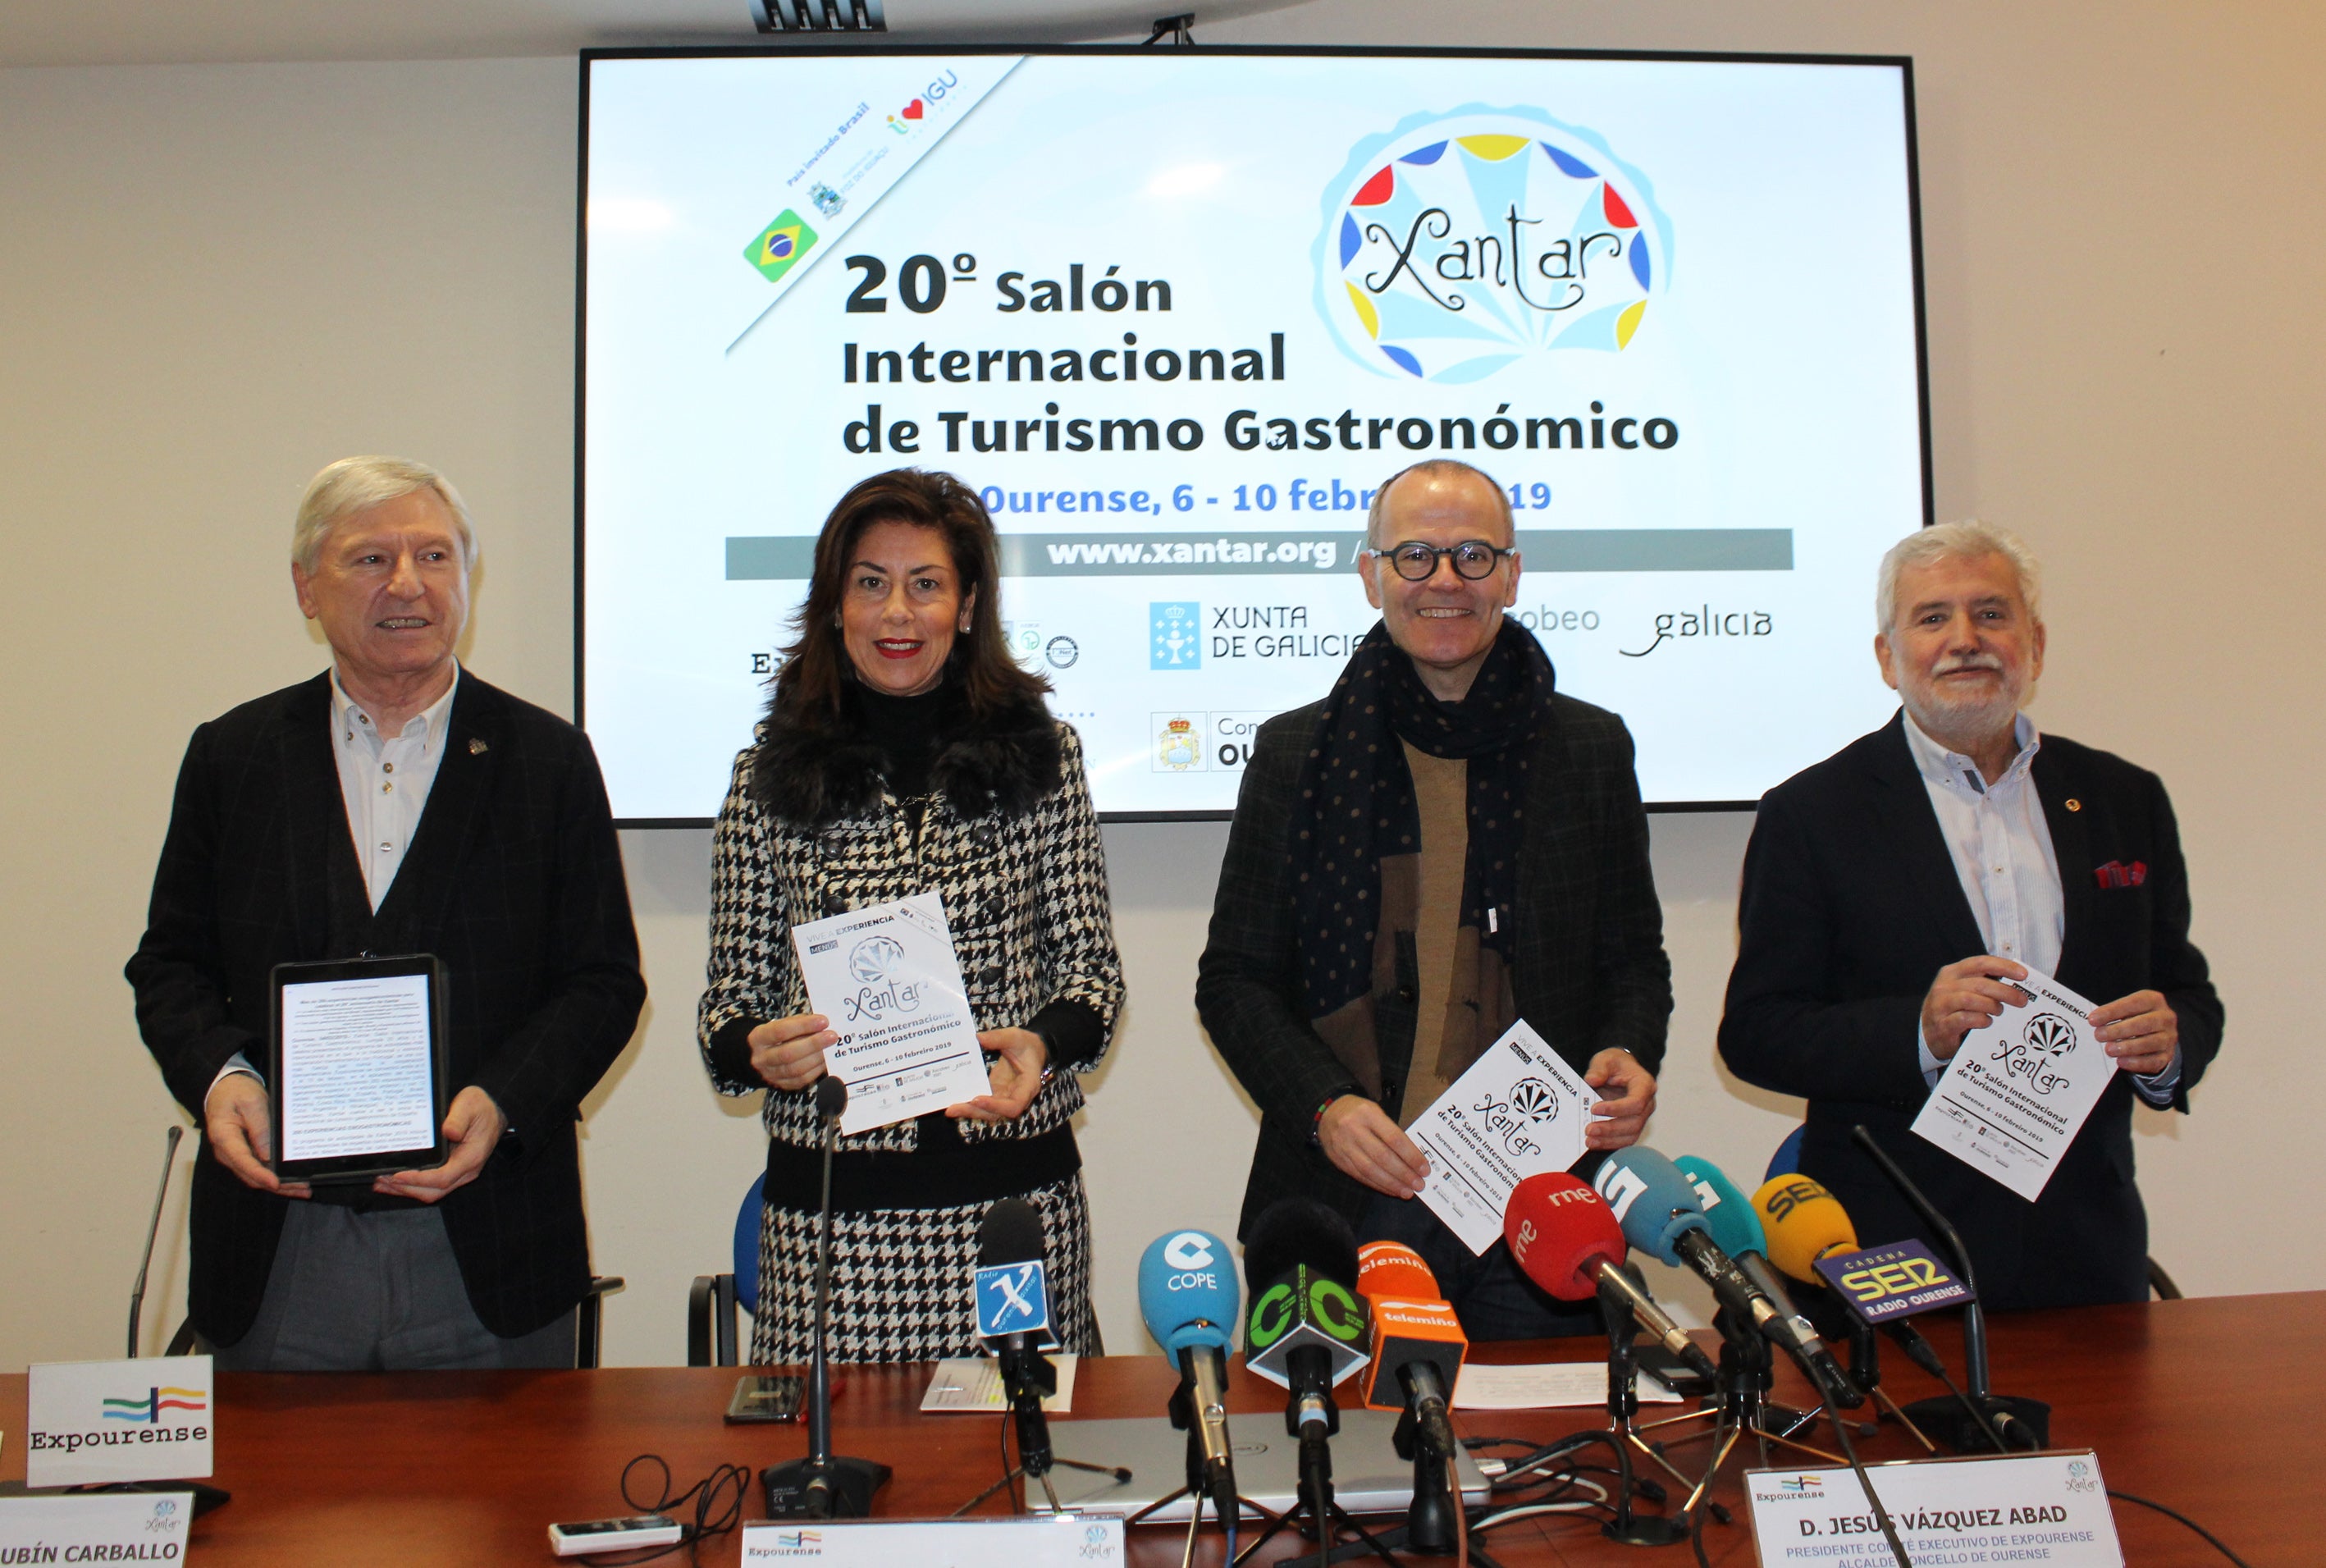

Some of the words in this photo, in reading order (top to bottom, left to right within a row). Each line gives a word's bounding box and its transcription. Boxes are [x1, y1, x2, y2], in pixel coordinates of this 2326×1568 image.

[921, 69, 957, 107] IGU
[838, 101, 871, 135] Brasil
[1365, 203, 1622, 311] Xantar
[843, 252, 978, 314] 20º
[996, 263, 1172, 313] Salón
[843, 331, 1286, 383] Internacional
[843, 404, 921, 453] de
[937, 402, 1204, 452] Turismo
[1224, 400, 1679, 451] Gastronómico
[985, 485, 1162, 516] Ourense,
[1172, 484, 1195, 512] 6
[1233, 482, 1277, 512] 10
[1289, 478, 1374, 512] febr
[1047, 538, 1337, 569] www.xantar.org
[1212, 606, 1309, 630] XUNTA
[1212, 635, 1247, 658] DE
[835, 915, 895, 936] EXPERIENCIA
[843, 979, 930, 1022] Xantar
[834, 1049, 848, 1058] de
[848, 1039, 889, 1056] Turismo
[891, 1019, 962, 1044] Gastronómico
[859, 1027, 886, 1041] Salón
[888, 1013, 956, 1034] Internacion
[853, 1060, 884, 1072] Ourense,
[895, 1054, 903, 1063] 10
[904, 1046, 935, 1059] febreiro
[935, 1041, 953, 1051] 2019
[1990, 1040, 2070, 1095] Xantar
[1536, 1054, 1579, 1098] EXPERIENCIA
[1957, 1068, 1969, 1079] de
[1969, 1075, 2004, 1099] Turismo
[2004, 1095, 2065, 1136] Gastronómico
[1984, 1072, 2009, 1090] Salón
[2008, 1086, 2068, 1125] Internacional
[1474, 1094, 1542, 1156] Xantar
[1959, 1090, 1986, 1110] Ourense,
[2002, 1114, 2029, 1135] febreiro
[2027, 1130, 2045, 1143] 2019
[1434, 1132, 1457, 1157] Ourense,
[1463, 1159, 1471, 1169] 10
[1469, 1166, 1490, 1190] febreiro
[1489, 1186, 1503, 1202] 2019
[1437, 1110, 1447, 1122] de
[1447, 1118, 1476, 1150] Turismo
[1475, 1148, 1515, 1190] Gastronóm
[1462, 1121, 1483, 1143] Salón
[1482, 1140, 1523, 1184] Internacion
[1548, 1188, 1597, 1207] rne
[1515, 1219, 1538, 1264] rne
[1359, 1255, 1433, 1278] elemiñ
[1844, 1250, 1907, 1270] CADENA
[1168, 1273, 1218, 1291] COPE
[1841, 1257, 1950, 1302] SER
[1865, 1299, 1908, 1317] RADIO
[1909, 1284, 1967, 1306] OURENSE
[1384, 1312, 1458, 1328] telemiño
[30, 1426, 208, 1453] Expourense
[1756, 1490, 1825, 1503] Expourense
[1799, 1519, 1823, 1537] D.
[1900, 1506, 2004, 1532] VÁZQUEZ
[2009, 1505, 2068, 1525] ABAD
[1, 1541, 58, 1565] UBÍN
[64, 1543, 179, 1563] CARBALLO
[748, 1547, 823, 1559] Expourense
[1786, 1543, 1865, 1559] PRESIDENTE
[1867, 1538, 1917, 1555] COMTÉ
[1918, 1535, 1989, 1552] EXECUTIVO
[1990, 1535, 2008, 1546] DE
[2011, 1530, 2095, 1547] EXPOURENSE
[1838, 1556, 1896, 1568] ALCALDE
[1908, 1552, 1968, 1567] ONCELLO
[1971, 1551, 1989, 1564] DE
[1990, 1547, 2051, 1561] OURENSE
